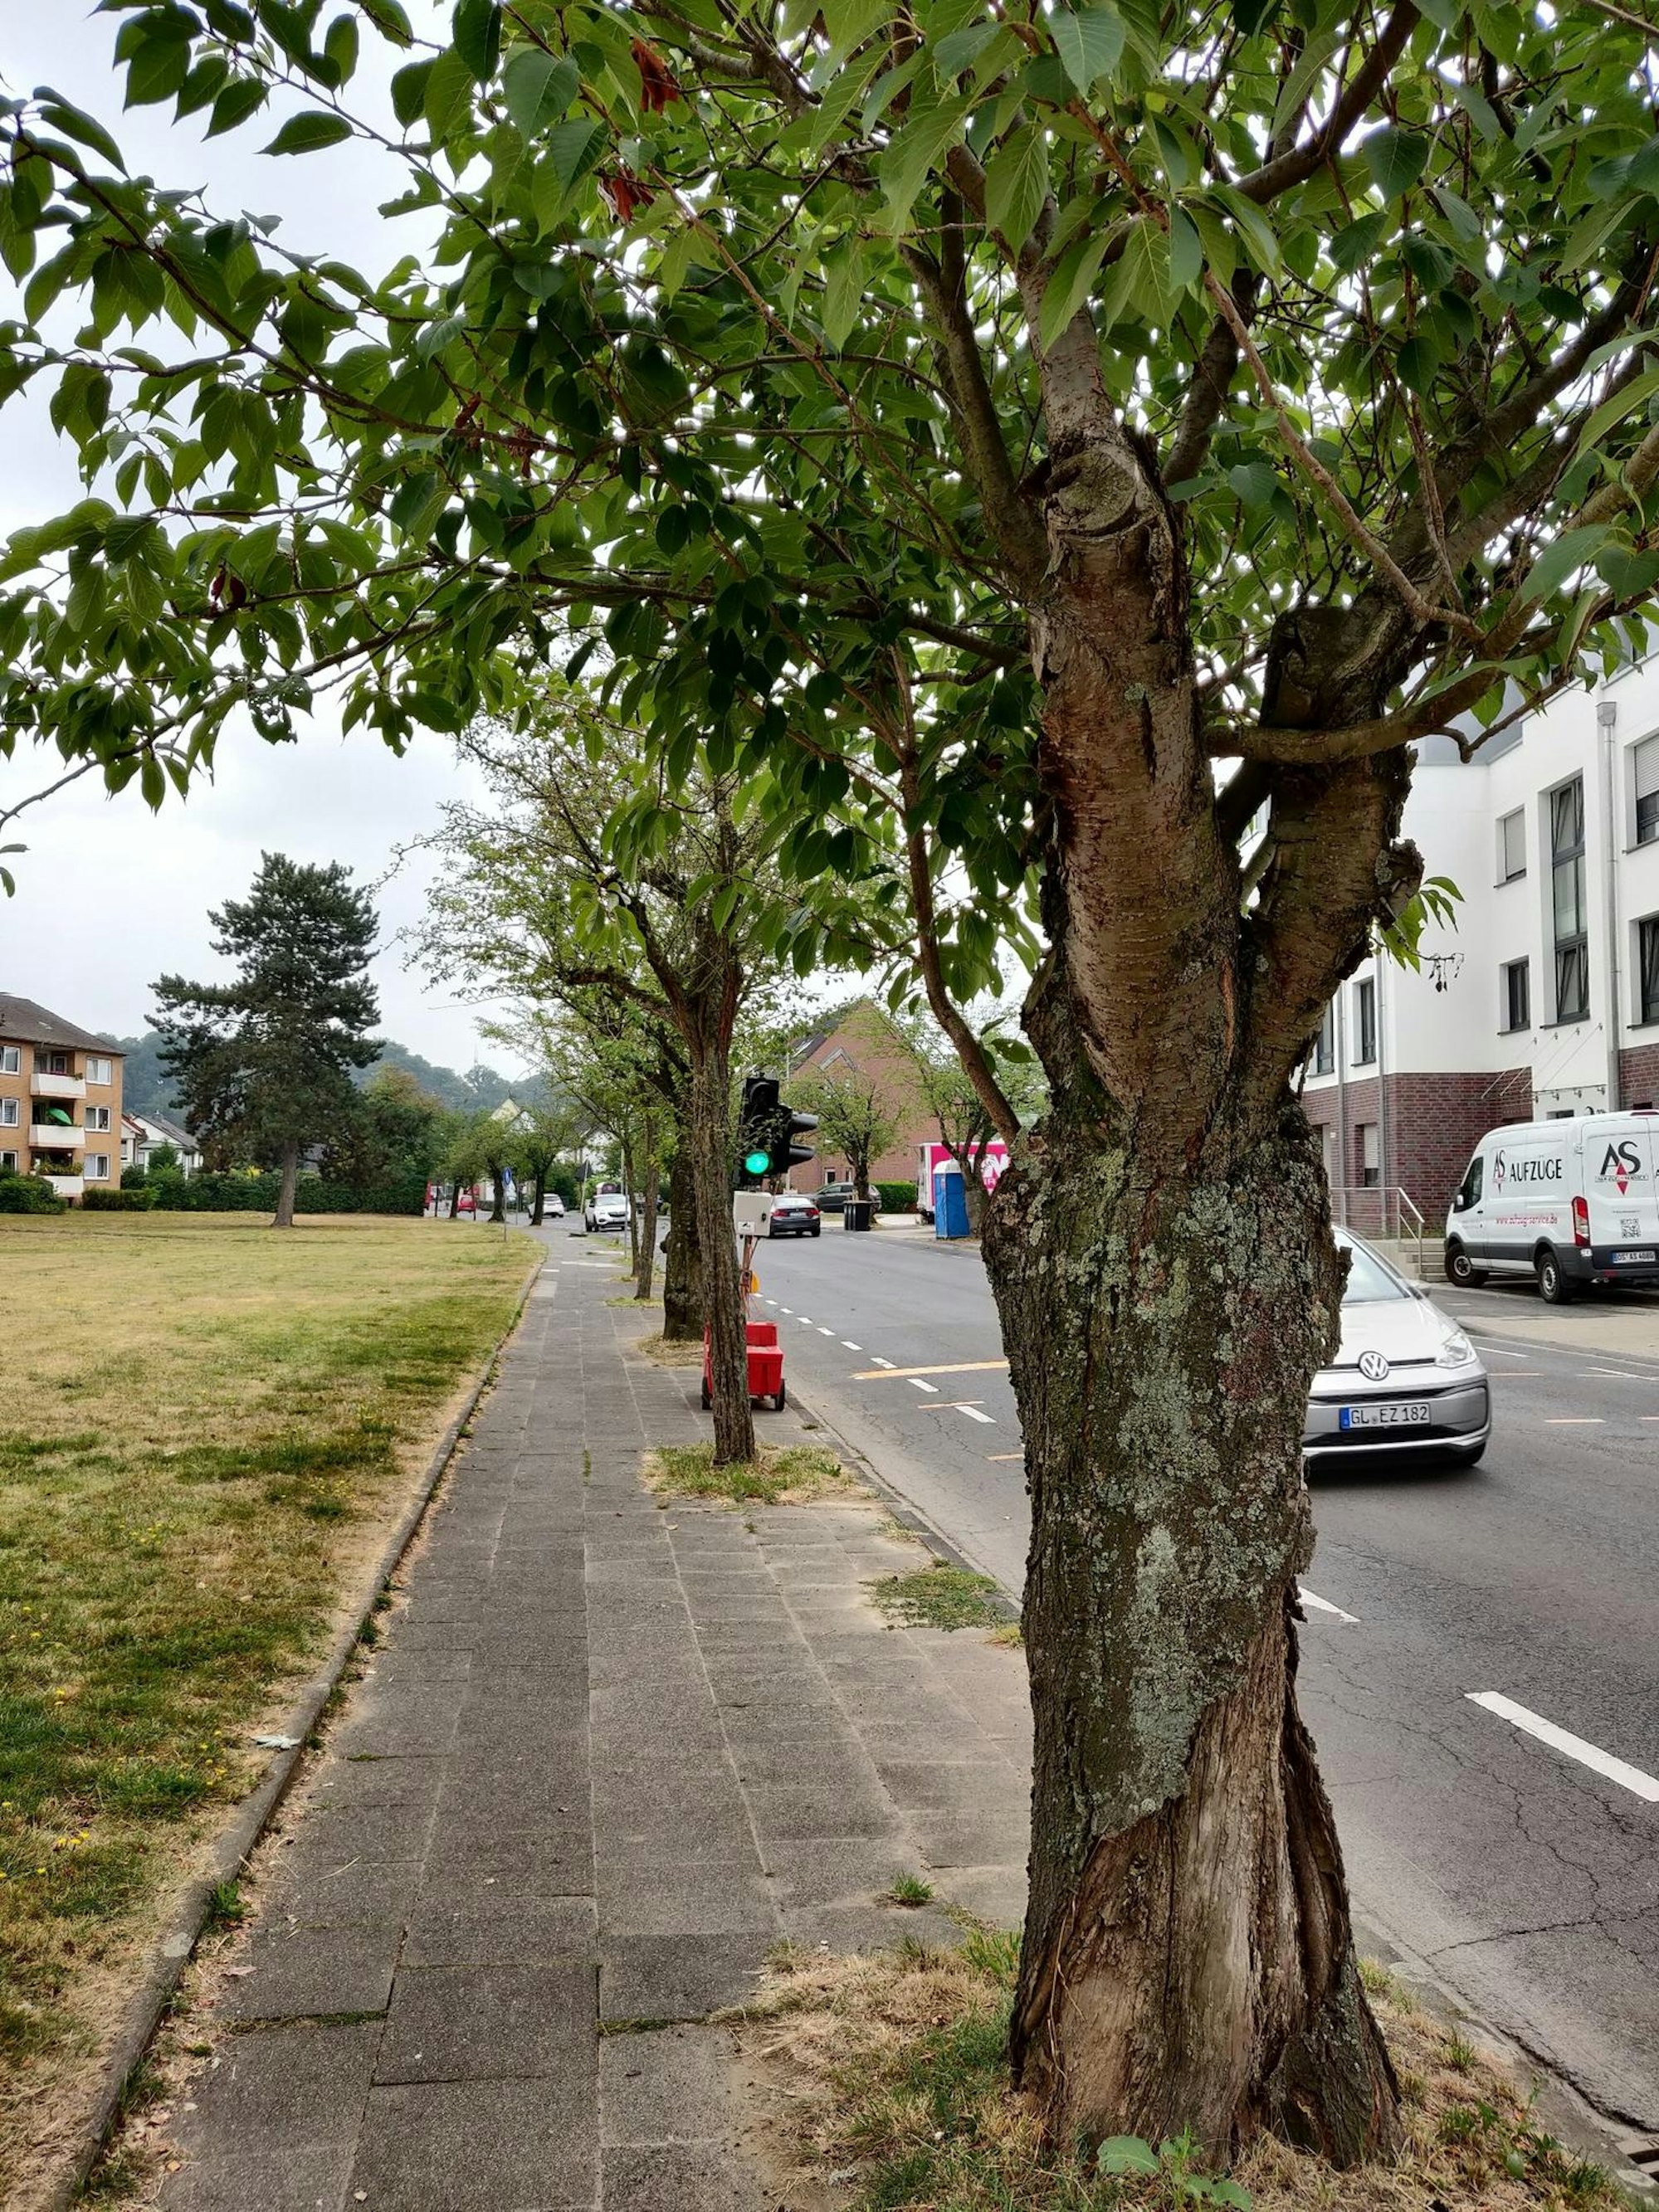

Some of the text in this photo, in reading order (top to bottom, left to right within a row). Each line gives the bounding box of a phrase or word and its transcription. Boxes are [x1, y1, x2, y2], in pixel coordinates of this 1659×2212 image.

[1493, 1150, 1562, 1182] AS AUFZÜGE
[1600, 1141, 1642, 1176] AS
[1351, 1406, 1428, 1424] GL EZ 182
